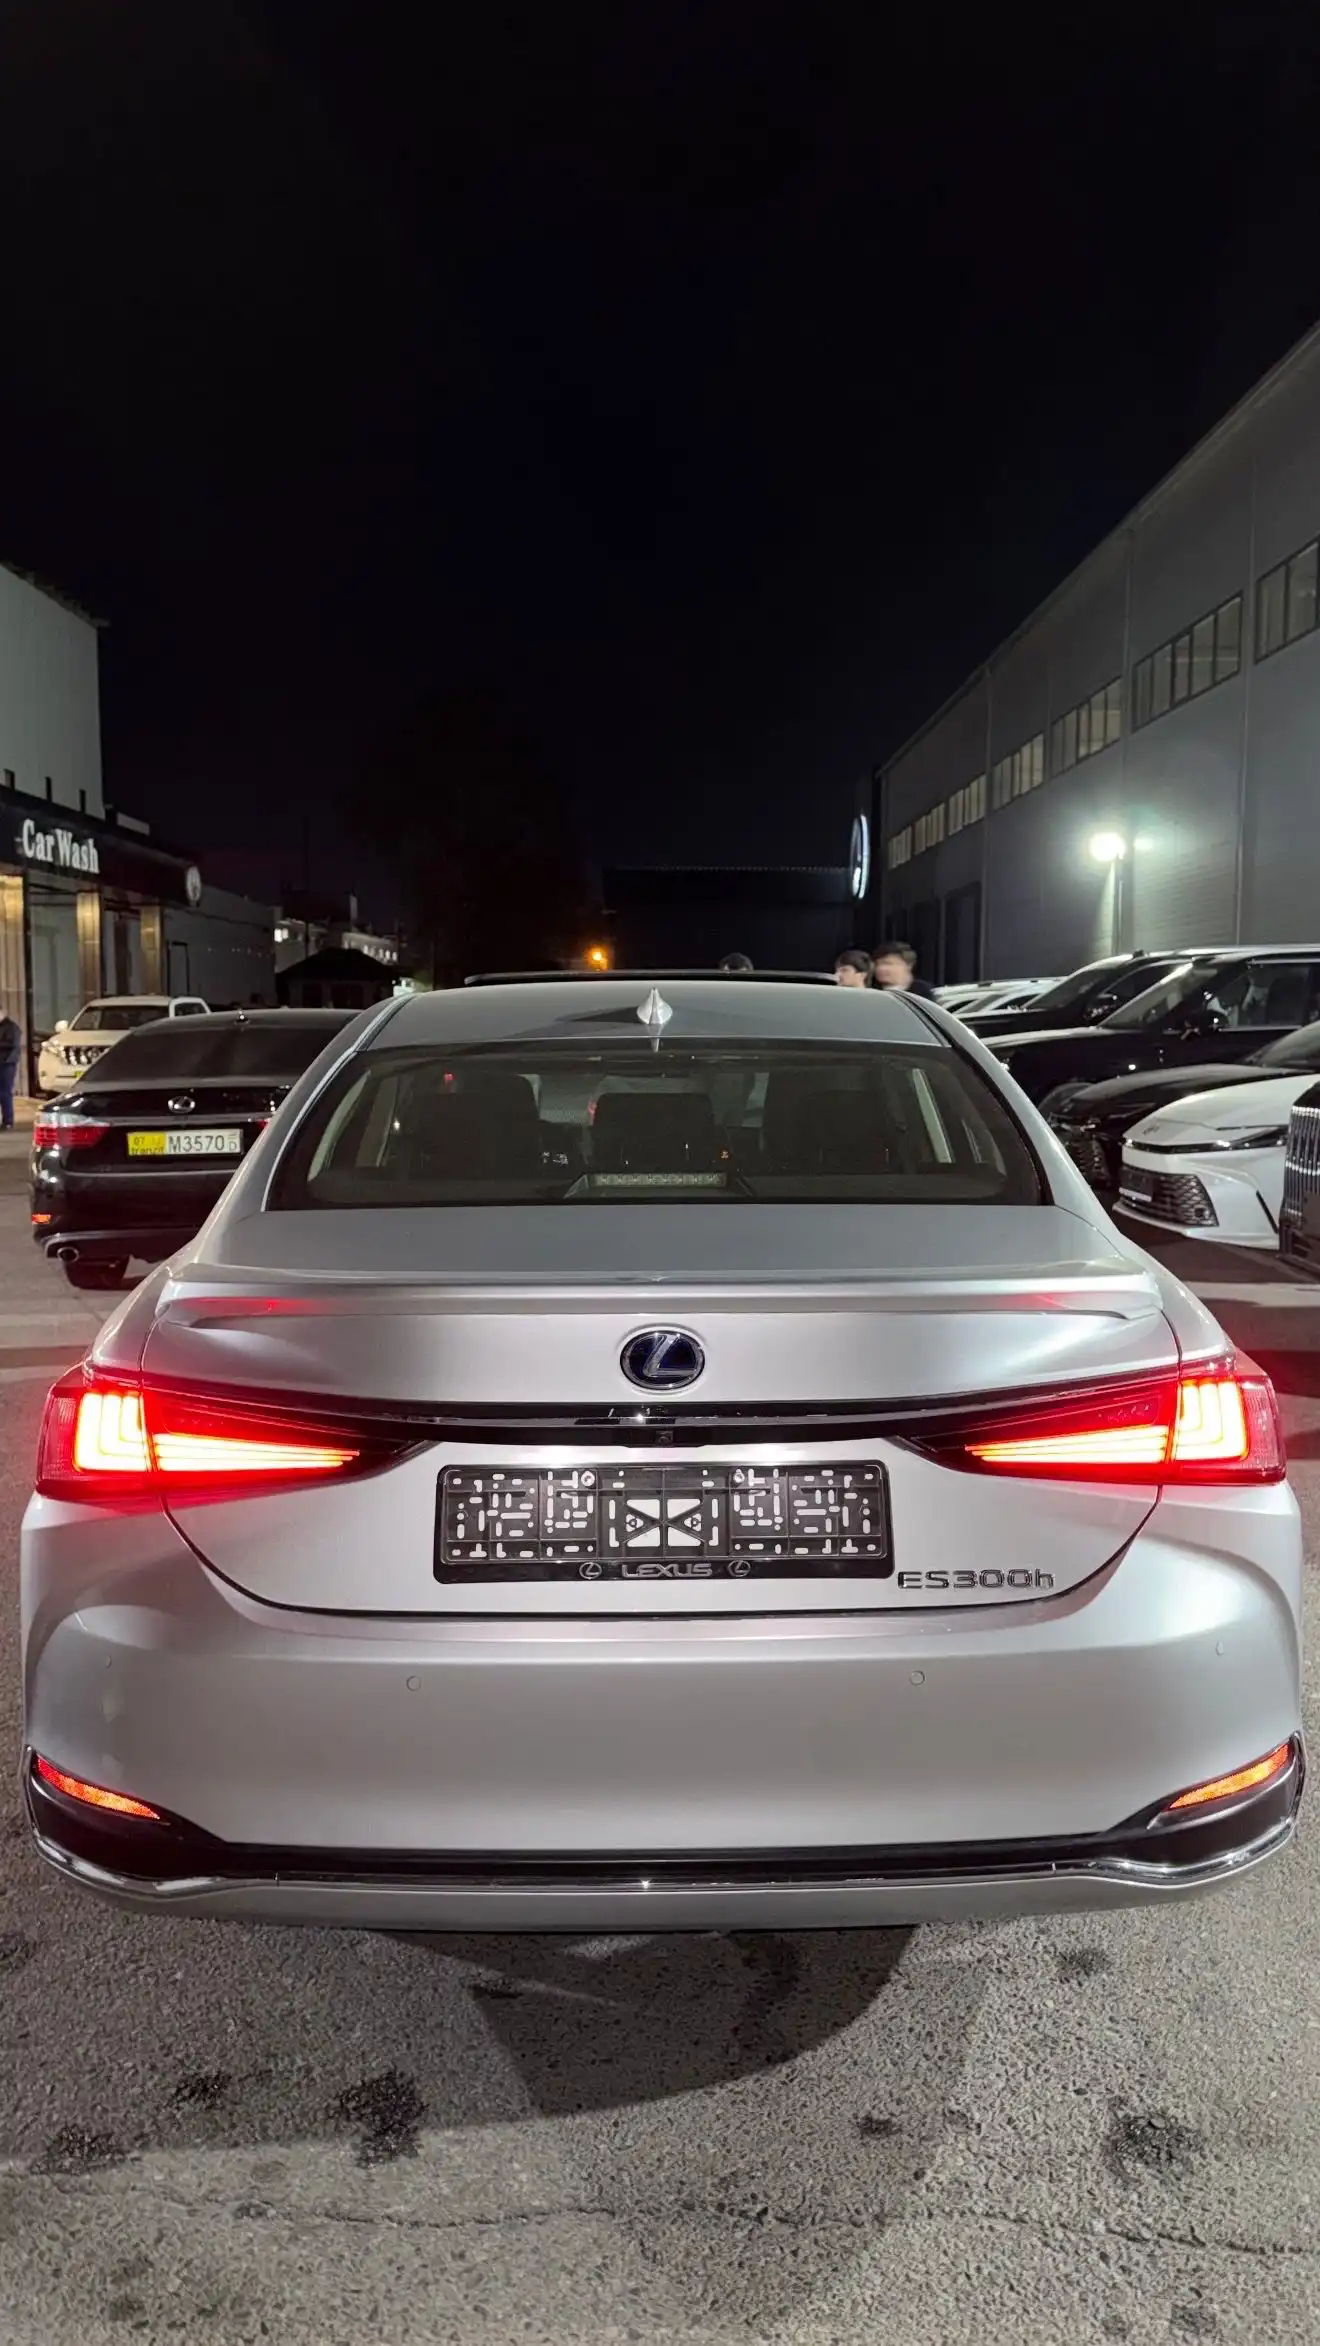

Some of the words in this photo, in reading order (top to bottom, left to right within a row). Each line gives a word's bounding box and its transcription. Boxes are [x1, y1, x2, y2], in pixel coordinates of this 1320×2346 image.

[22, 818, 55, 862] Car
[55, 828, 100, 874] Wash
[168, 1134, 225, 1153] M3570
[621, 1563, 713, 1578] LEXUS
[897, 1568, 1055, 1589] ES300h
